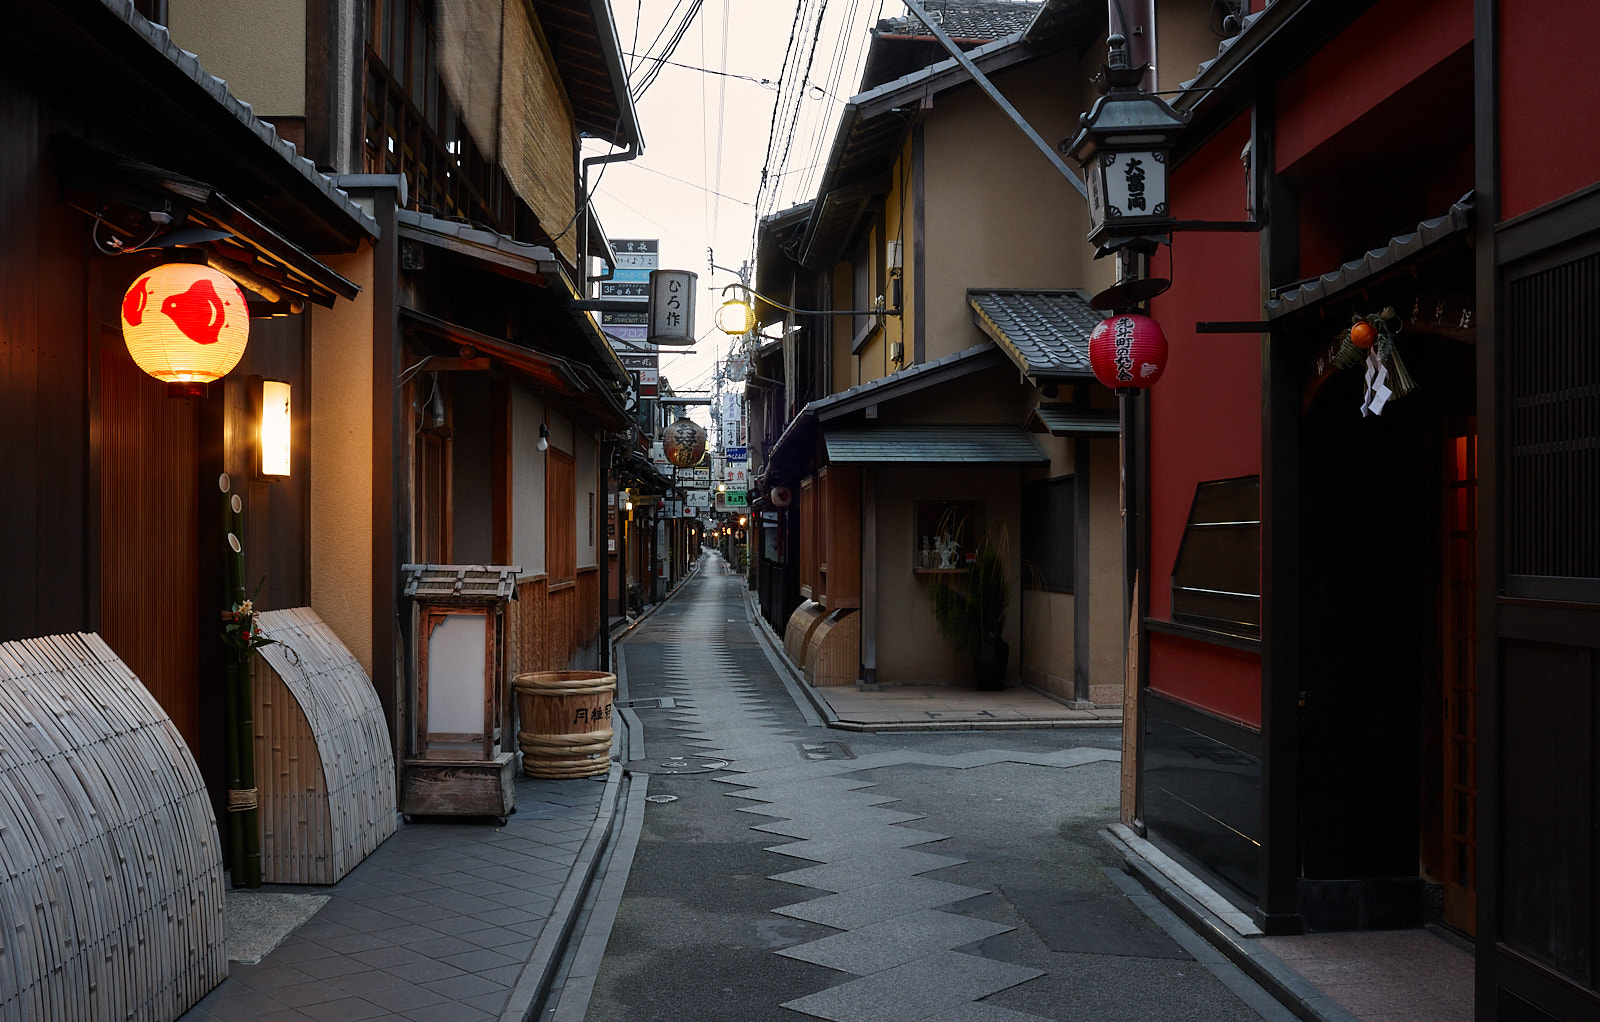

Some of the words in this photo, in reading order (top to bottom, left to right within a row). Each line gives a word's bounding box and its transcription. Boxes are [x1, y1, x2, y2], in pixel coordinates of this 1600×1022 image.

[604, 285, 615, 294] 3F
[667, 279, 682, 327] ひろ作
[1115, 317, 1135, 382] 先斗町のれん会
